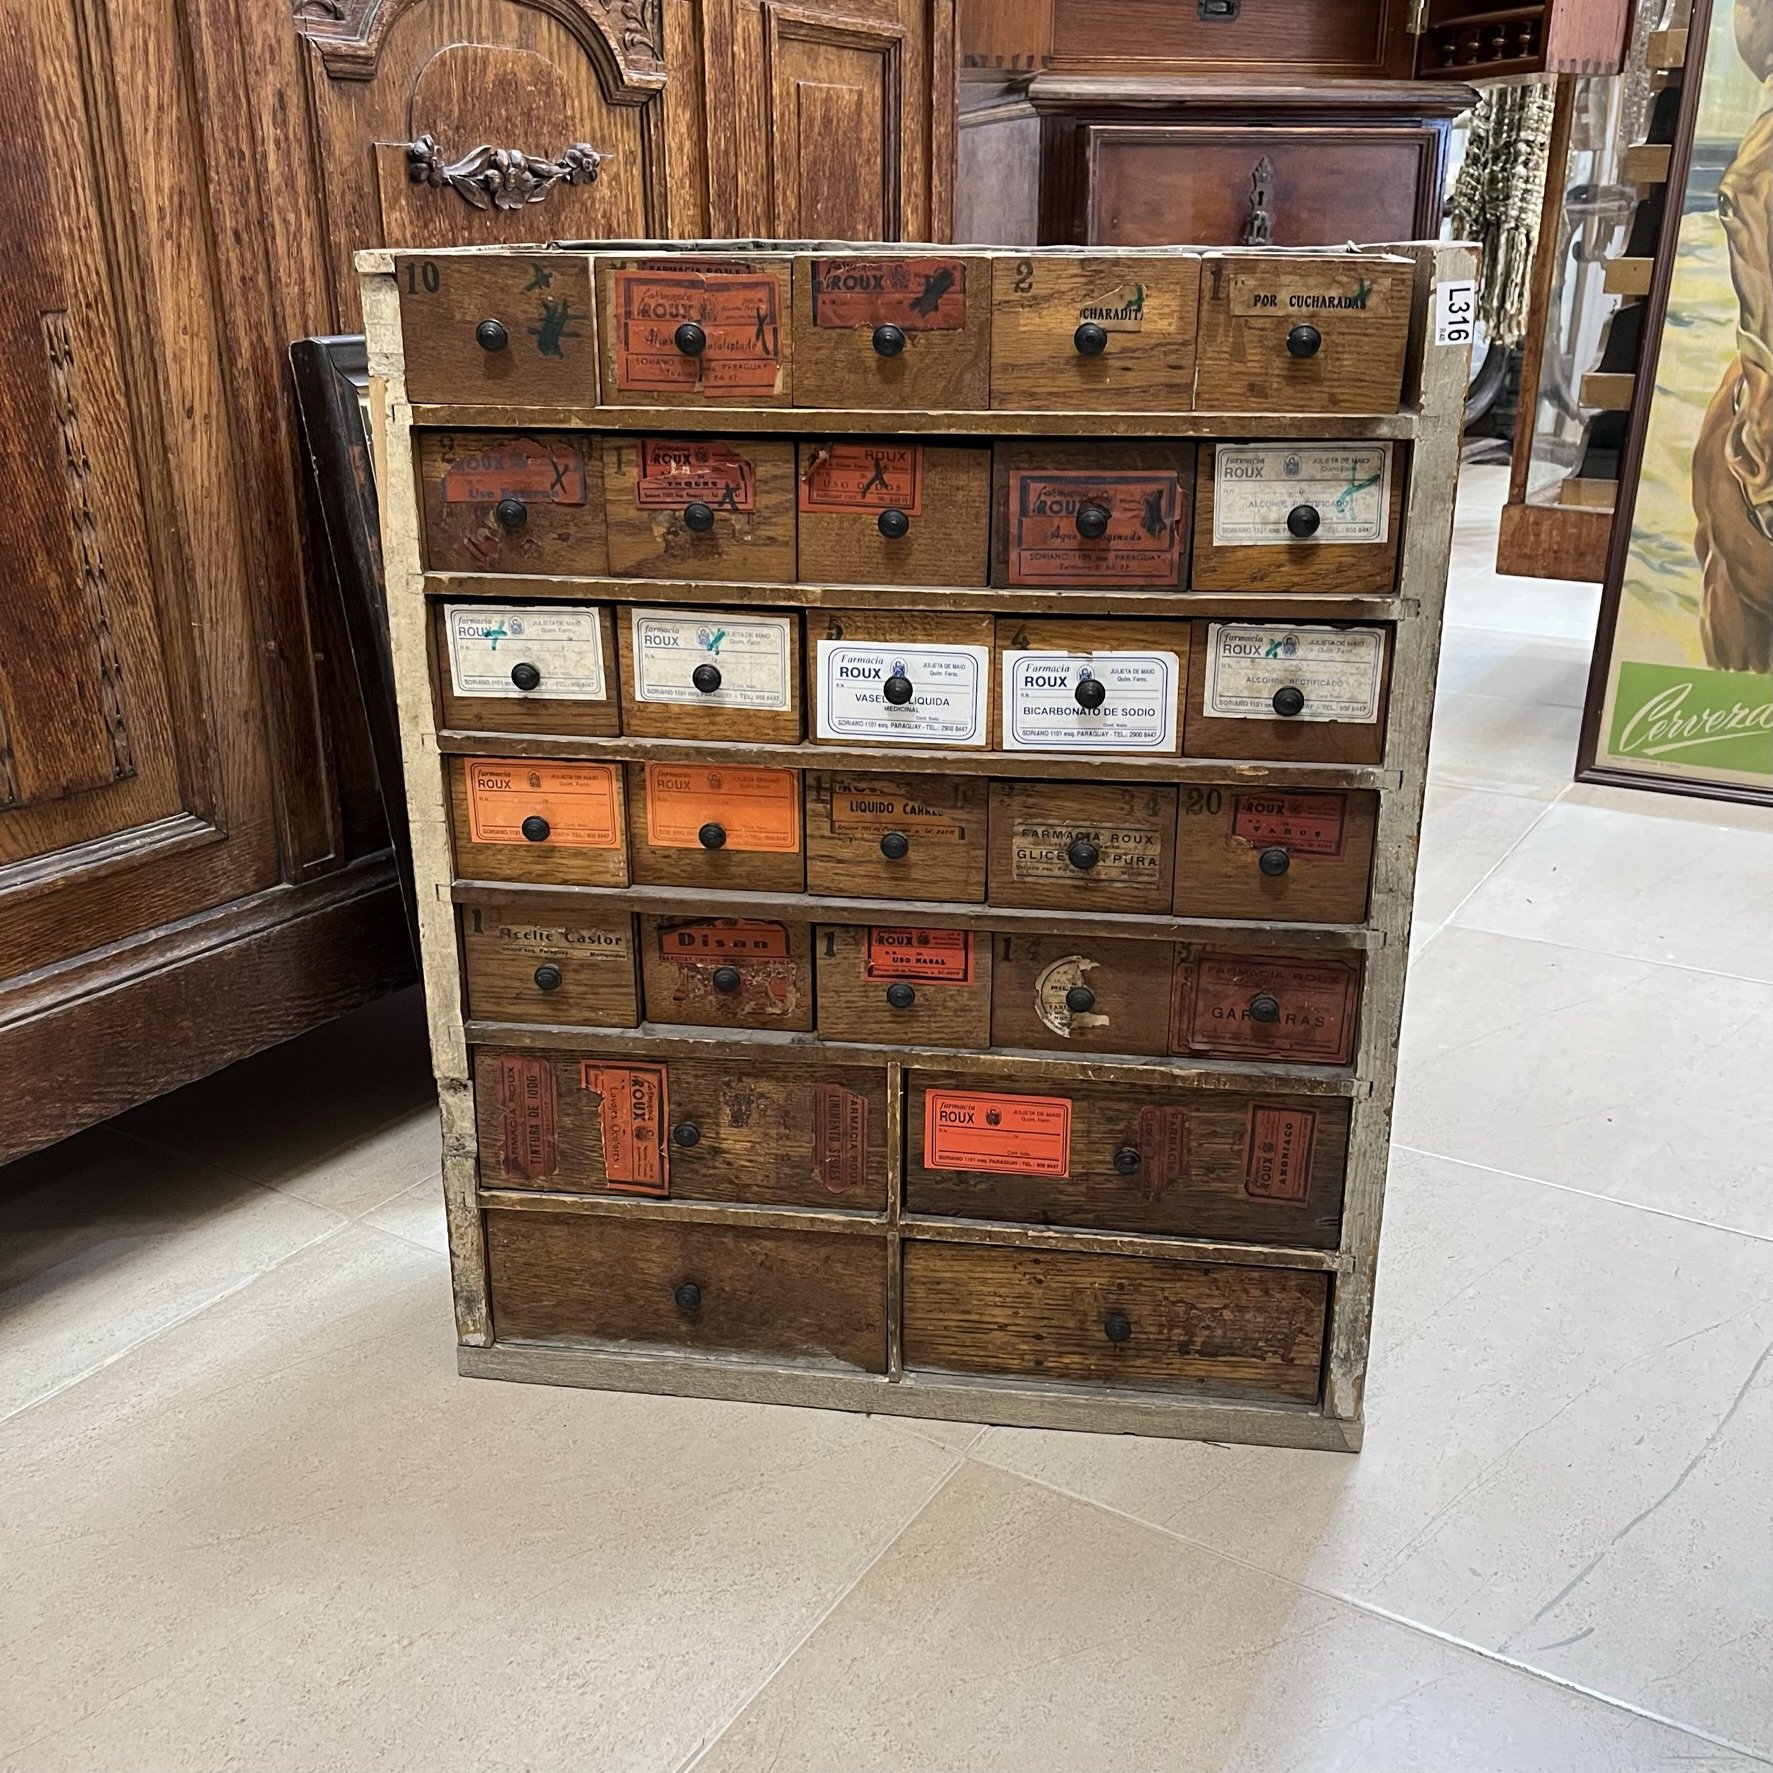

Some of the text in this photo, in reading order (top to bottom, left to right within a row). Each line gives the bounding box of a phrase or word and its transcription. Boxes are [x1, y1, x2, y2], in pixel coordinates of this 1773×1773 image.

[405, 261, 440, 295] 10
[827, 274, 886, 291] ROUX
[1014, 259, 1034, 294] 2
[1253, 294, 1367, 310] POR CUCHARADAS
[638, 302, 694, 320] ROUX
[1079, 307, 1144, 321] CHARADIT
[1447, 287, 1471, 341] L316
[652, 452, 691, 465] ROUX
[1223, 466, 1264, 479] ROUX
[823, 479, 849, 489] USO
[1034, 499, 1077, 515] ROU
[644, 634, 680, 647] ROUX
[1222, 643, 1262, 656] ROUX
[841, 653, 884, 666] Farmacia
[839, 666, 882, 680] ROUX
[1026, 663, 1070, 674] Farmacia
[1109, 667, 1132, 676] JULIETA
[1024, 676, 1068, 688] ROUX
[883, 705, 920, 714] MEDICINAL
[1023, 706, 1156, 717] BICARBONATO DE SODIO
[837, 719, 864, 728] SORIANO
[890, 722, 922, 730] PARAGUAY
[1619, 683, 1773, 752] Cerveza
[477, 778, 512, 790] ROUX
[656, 778, 692, 791] ROUX
[849, 799, 895, 815] LIQUIDO
[1185, 787, 1222, 816] 20
[1243, 801, 1286, 815] ROUX
[1021, 828, 1154, 845] FARMACIA ROUX
[1112, 854, 1158, 867] PURA
[564, 930, 623, 946] Castor
[877, 935, 913, 946] ROUX
[1207, 965, 1340, 984] FARMACIA ROUX
[506, 1065, 516, 1104] ROUX
[631, 1075, 647, 1121] ROUX
[527, 1105, 540, 1118] DE
[939, 1101, 976, 1111] farmacia
[939, 1110, 975, 1124] ROUX
[529, 1121, 542, 1166] TINTURA
[850, 1094, 859, 1186] FARMACIA ROUX
[1260, 1157, 1274, 1193] ROUX
